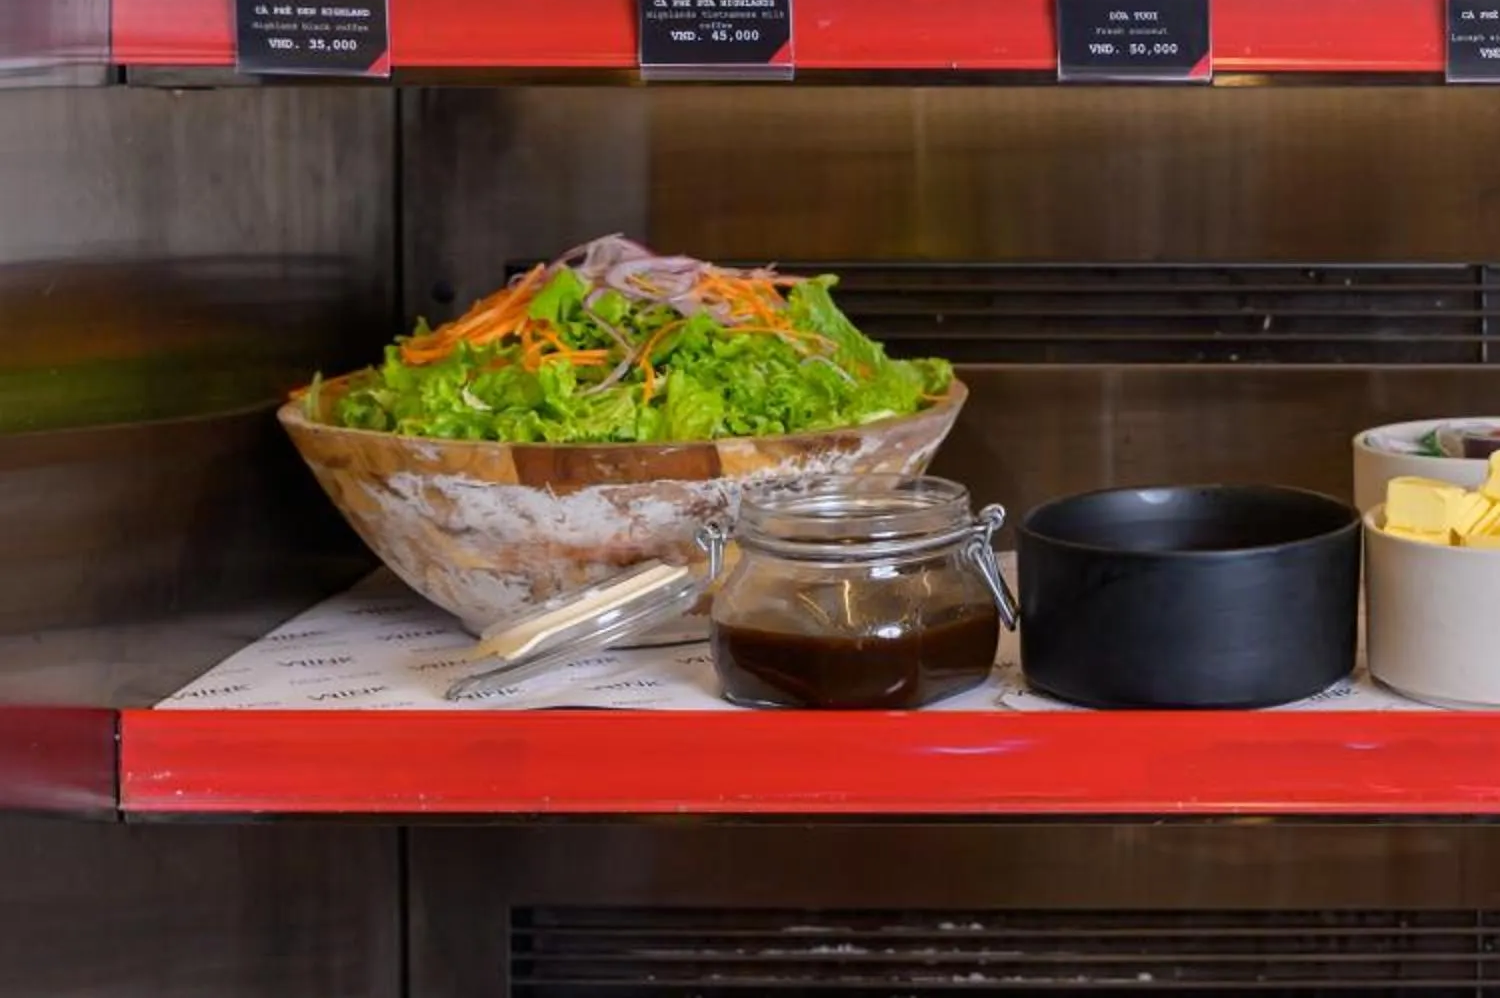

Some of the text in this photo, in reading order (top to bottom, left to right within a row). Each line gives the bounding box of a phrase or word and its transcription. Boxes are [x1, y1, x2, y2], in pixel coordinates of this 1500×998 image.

[670, 29, 760, 42] VND. 45,000
[268, 38, 357, 51] VND. 35,000
[1088, 43, 1179, 56] VND. 50,000
